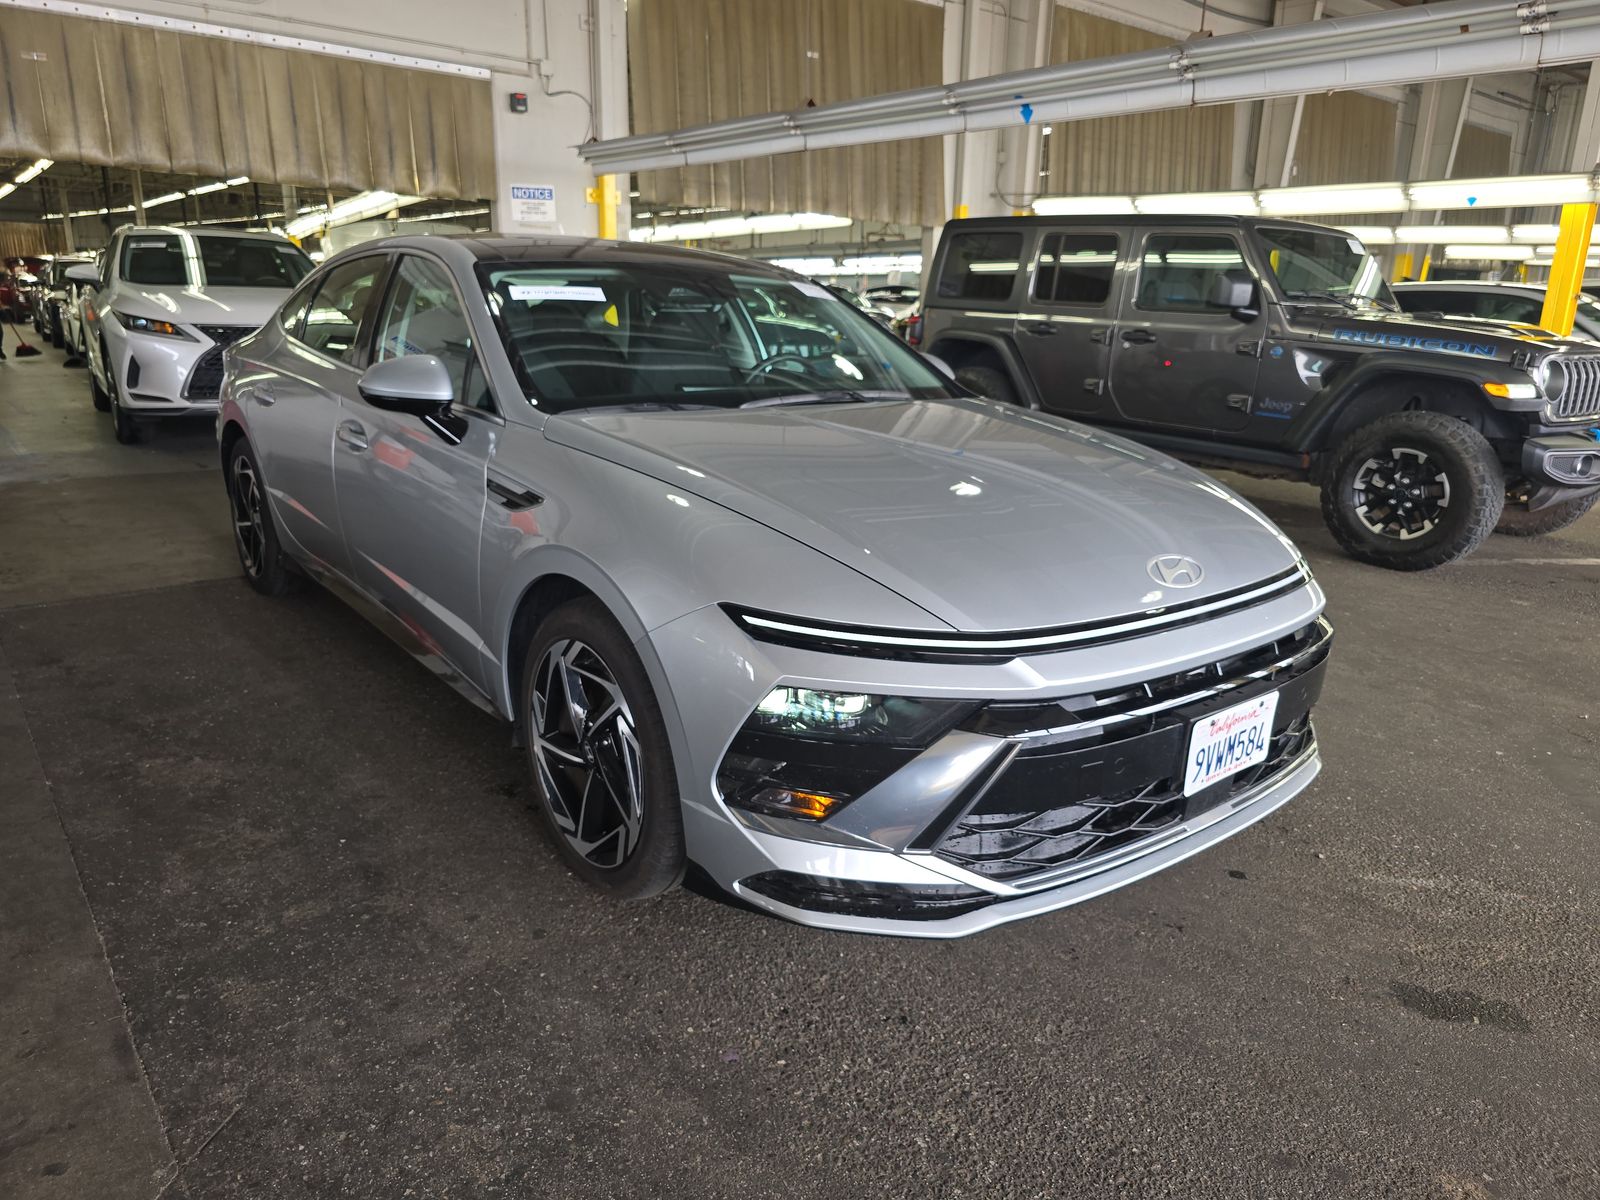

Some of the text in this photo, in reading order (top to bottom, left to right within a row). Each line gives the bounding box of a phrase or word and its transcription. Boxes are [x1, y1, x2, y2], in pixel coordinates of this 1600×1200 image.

[512, 187, 552, 199] NOTICE
[1333, 328, 1497, 358] RUBICON
[1259, 397, 1293, 413] Jeep
[1208, 709, 1261, 738] California
[1191, 721, 1265, 783] 9VWM584
